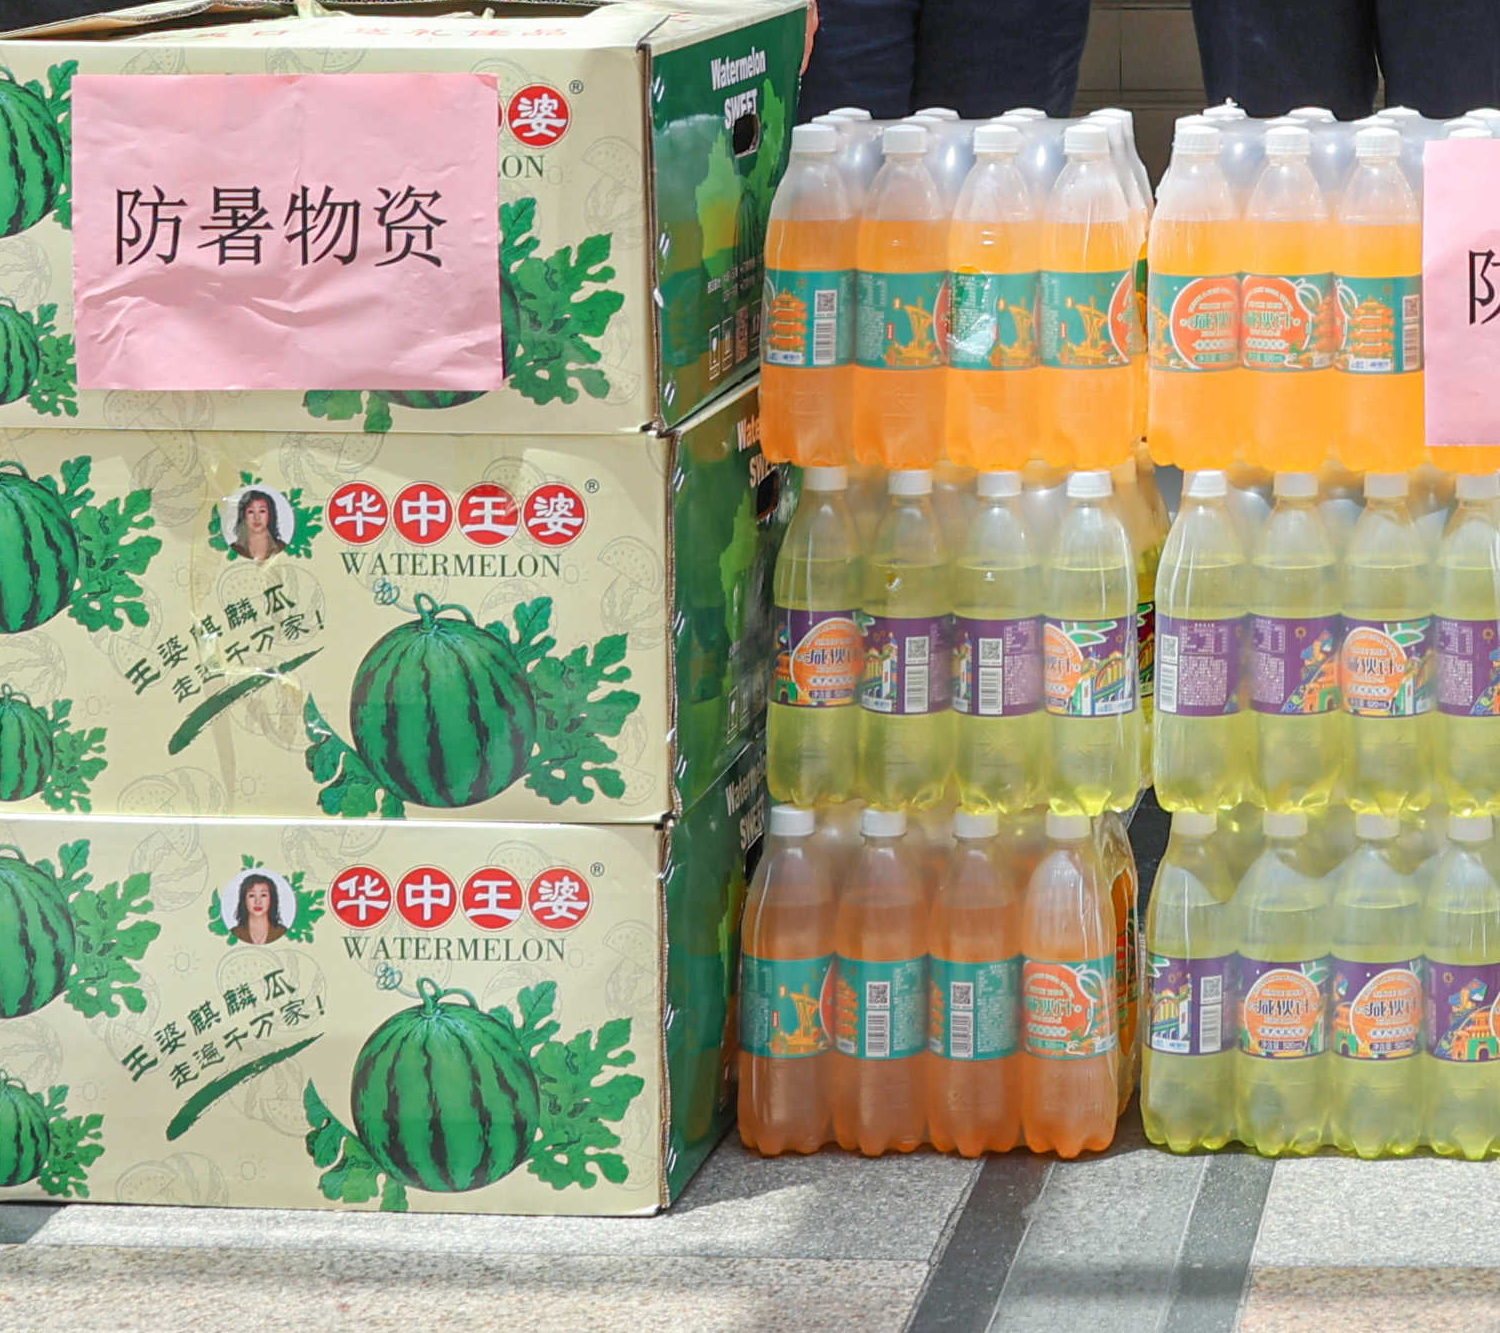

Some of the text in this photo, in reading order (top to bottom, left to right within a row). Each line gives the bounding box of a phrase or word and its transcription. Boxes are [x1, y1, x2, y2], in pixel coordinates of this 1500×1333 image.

[710, 46, 767, 91] Watermelon
[114, 185, 447, 268] 防暑物资
[334, 489, 584, 538] 华中王婆
[340, 551, 562, 577] WATERMELON
[336, 874, 589, 921] 华中王婆
[342, 936, 567, 962] WATERMELON
[121, 969, 296, 1082] 王婆麒麟瓜
[169, 995, 325, 1089] 走遍千万家!
